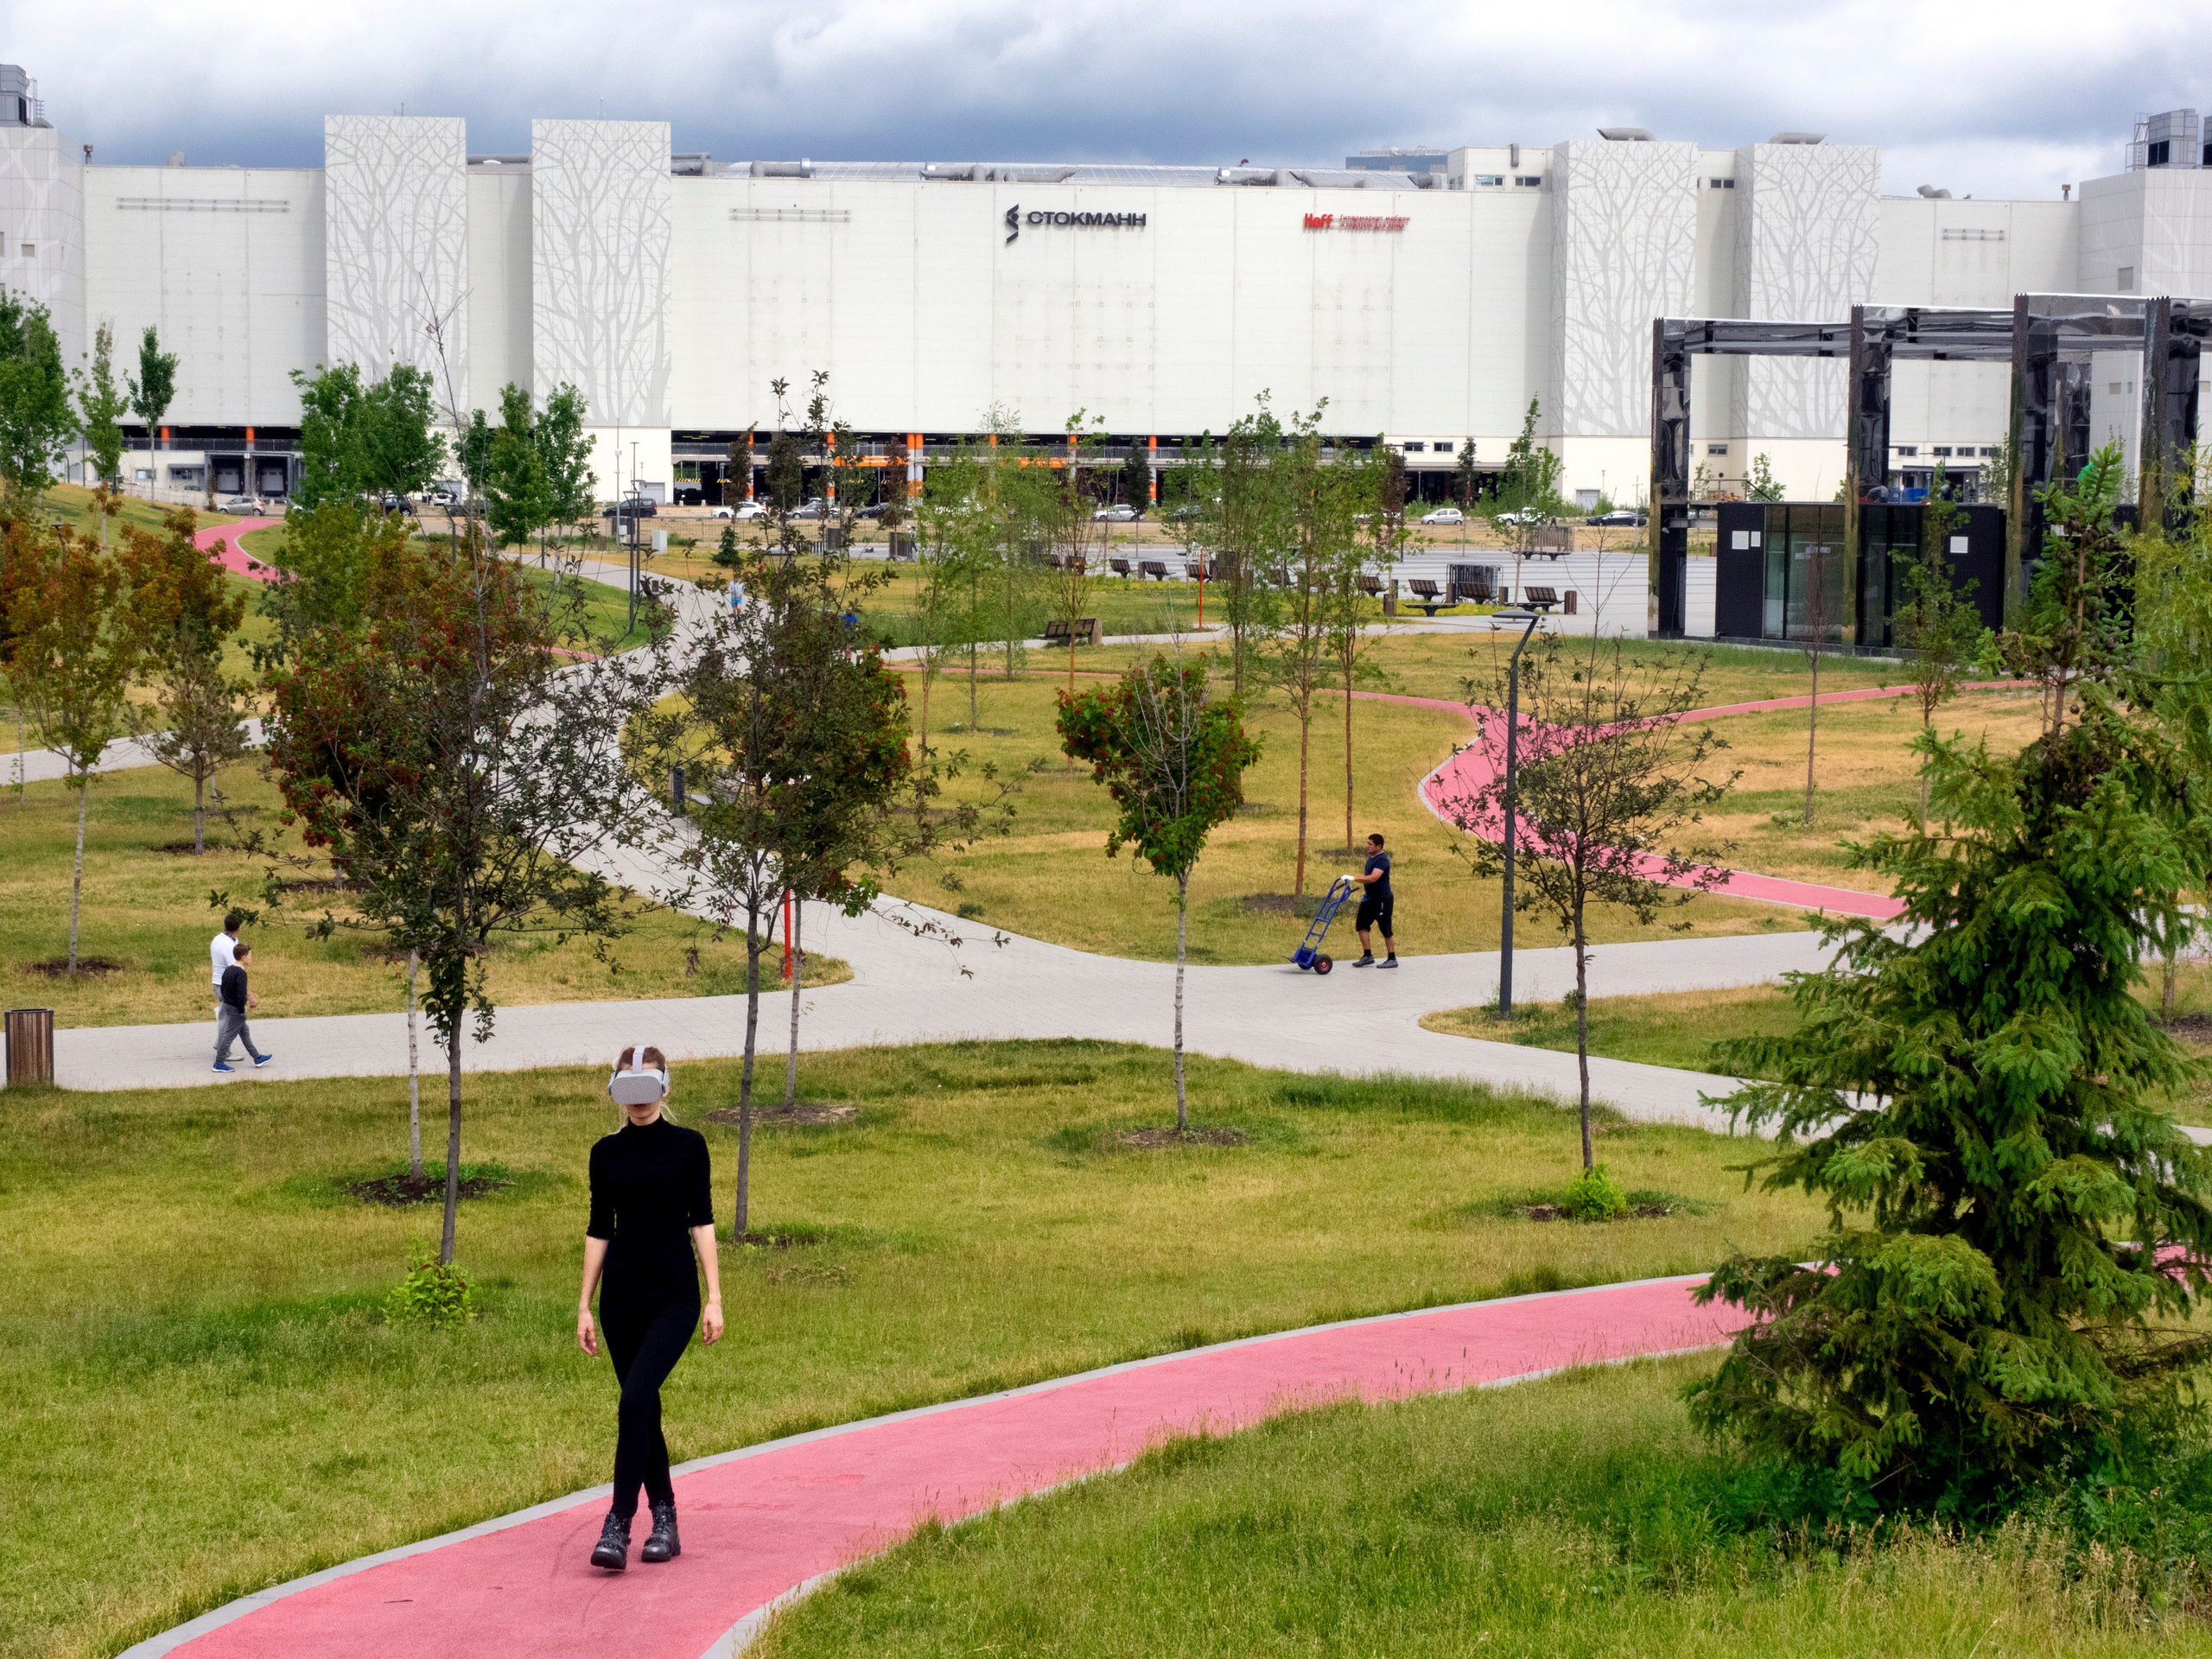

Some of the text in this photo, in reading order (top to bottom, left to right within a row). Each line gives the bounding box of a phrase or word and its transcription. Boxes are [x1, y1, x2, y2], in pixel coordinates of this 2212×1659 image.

[1027, 211, 1147, 226] СТОКМАНН
[1304, 213, 1333, 229] Hoff
[1340, 214, 1382, 223] Гипермаркет
